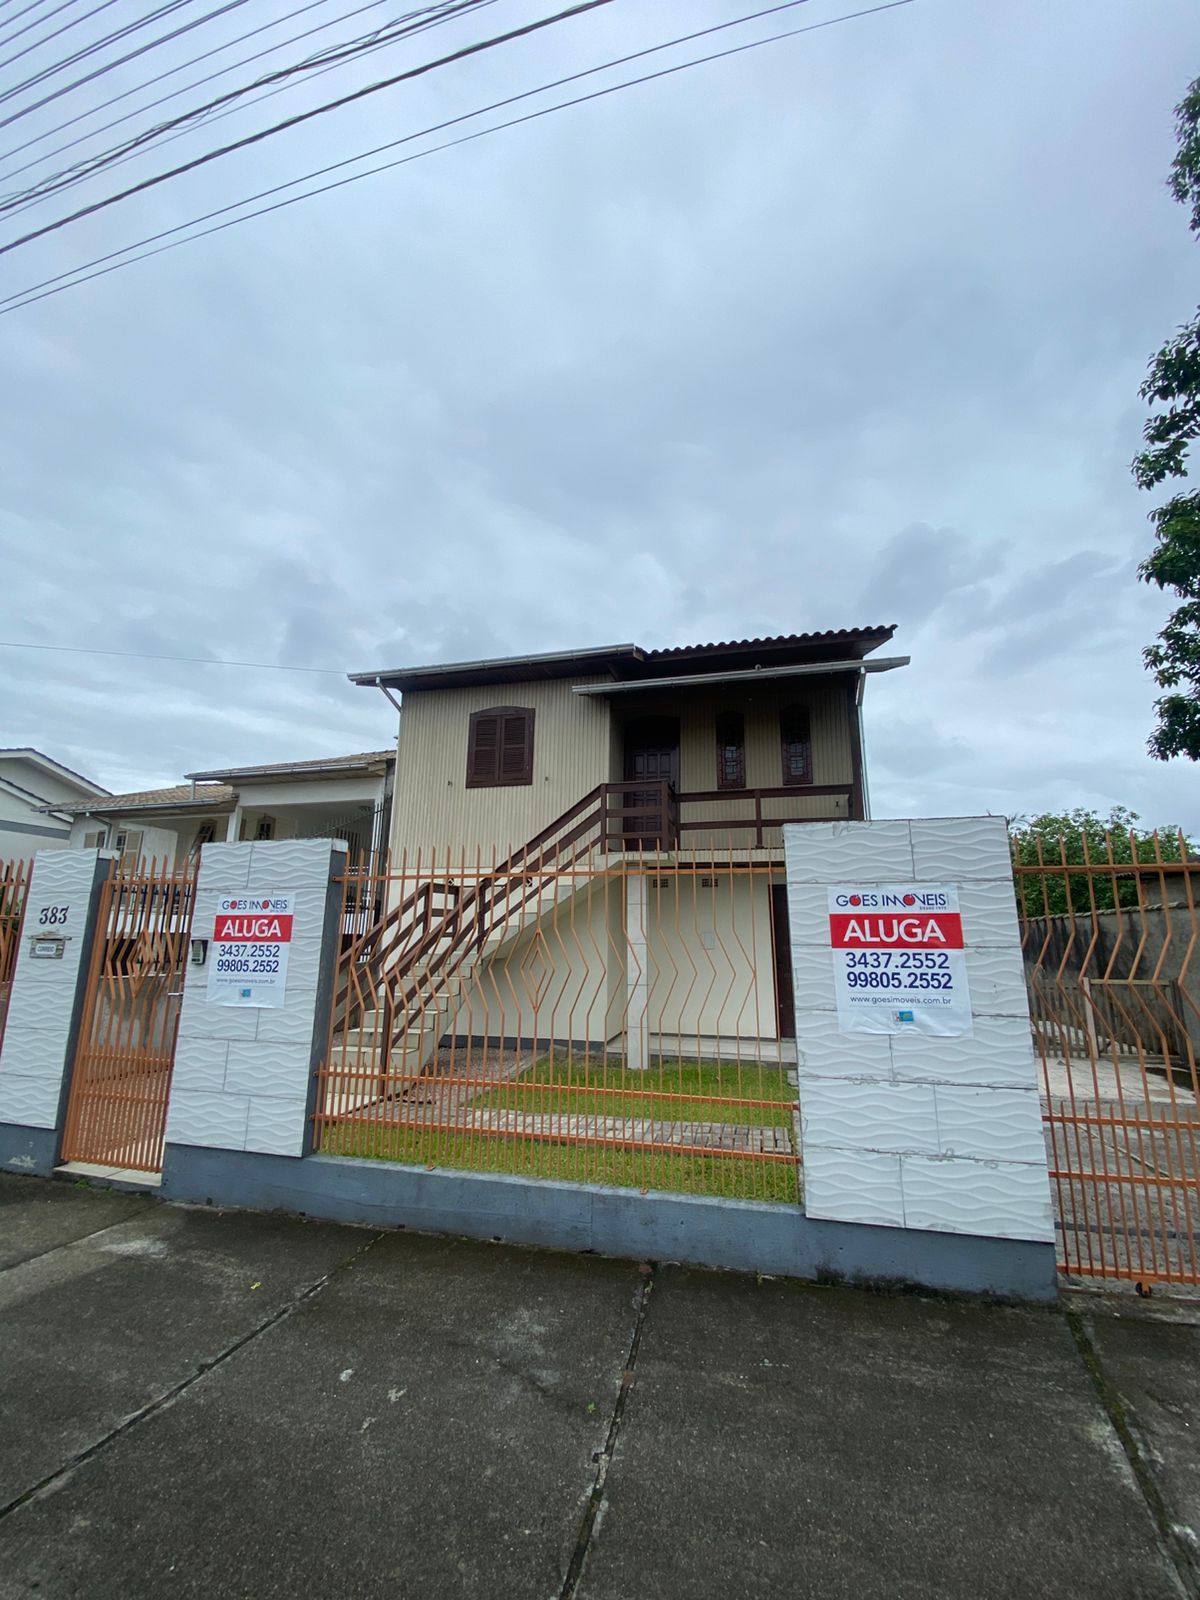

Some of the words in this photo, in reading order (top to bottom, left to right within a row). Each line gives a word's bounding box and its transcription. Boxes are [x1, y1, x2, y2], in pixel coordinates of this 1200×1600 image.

[222, 900, 247, 910] GOES
[836, 894, 878, 907] GOES
[39, 906, 70, 924] 383
[221, 919, 281, 937] ALUGA
[843, 919, 946, 942] ALUGA
[219, 944, 280, 958] 3437.2552
[217, 959, 279, 973] 99805.2552
[846, 952, 950, 969] 3437.2552
[847, 971, 953, 989] 99805.2552
[850, 996, 952, 1005] www.goesimoveis.com.br
